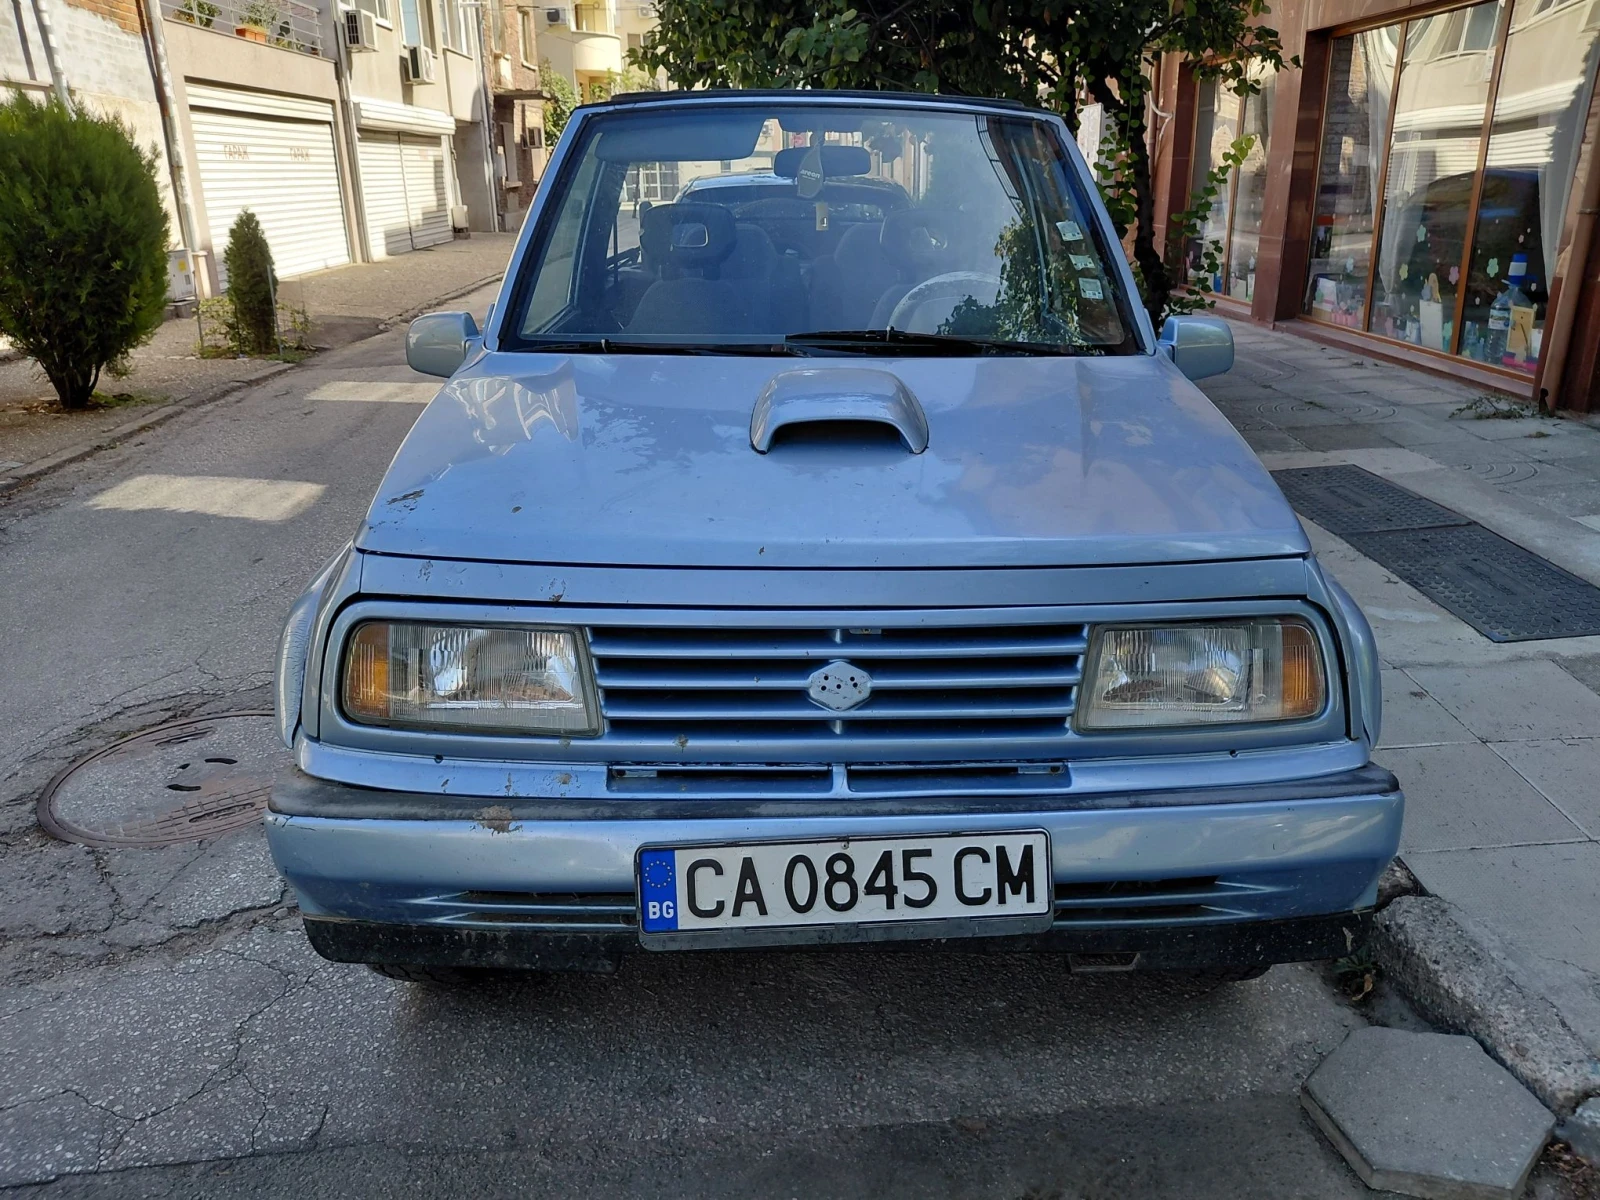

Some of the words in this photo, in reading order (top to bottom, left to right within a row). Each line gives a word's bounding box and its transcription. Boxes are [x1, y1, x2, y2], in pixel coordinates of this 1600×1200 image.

[223, 144, 250, 160] ГАРАЖ
[686, 856, 768, 918] CA
[784, 848, 938, 914] 0845
[954, 845, 1036, 906] CM
[648, 901, 674, 919] BG
